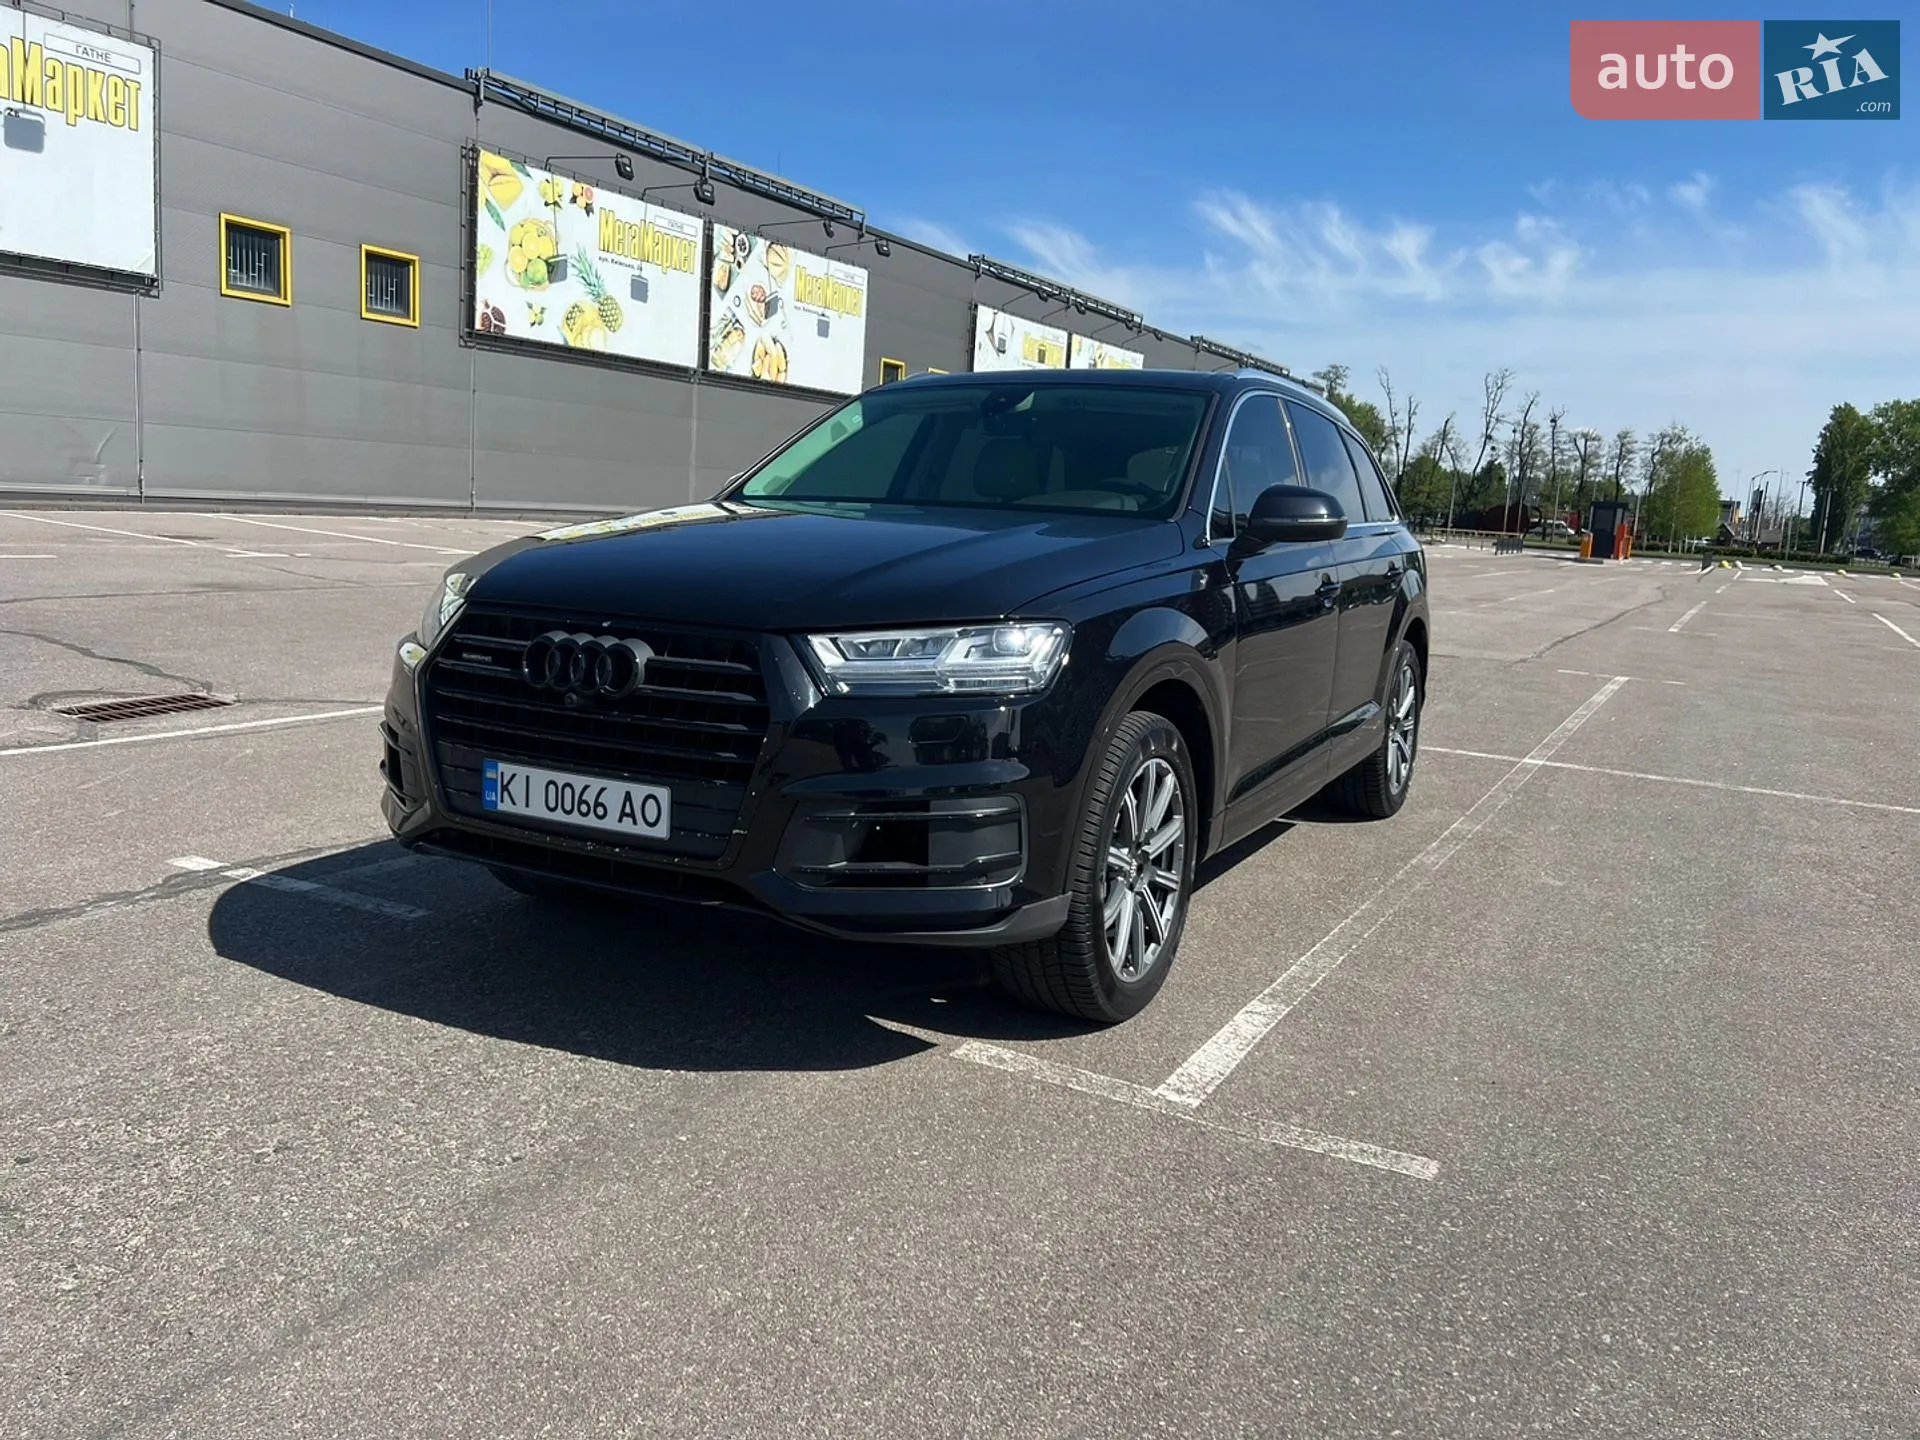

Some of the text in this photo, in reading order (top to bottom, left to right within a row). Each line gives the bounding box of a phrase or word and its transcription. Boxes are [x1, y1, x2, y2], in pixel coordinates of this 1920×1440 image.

[75, 44, 112, 64] ГАТНЕ
[599, 207, 698, 275] МегаМаркет
[500, 771, 530, 808] KI
[544, 779, 608, 821] 0066
[617, 790, 662, 829] AO
